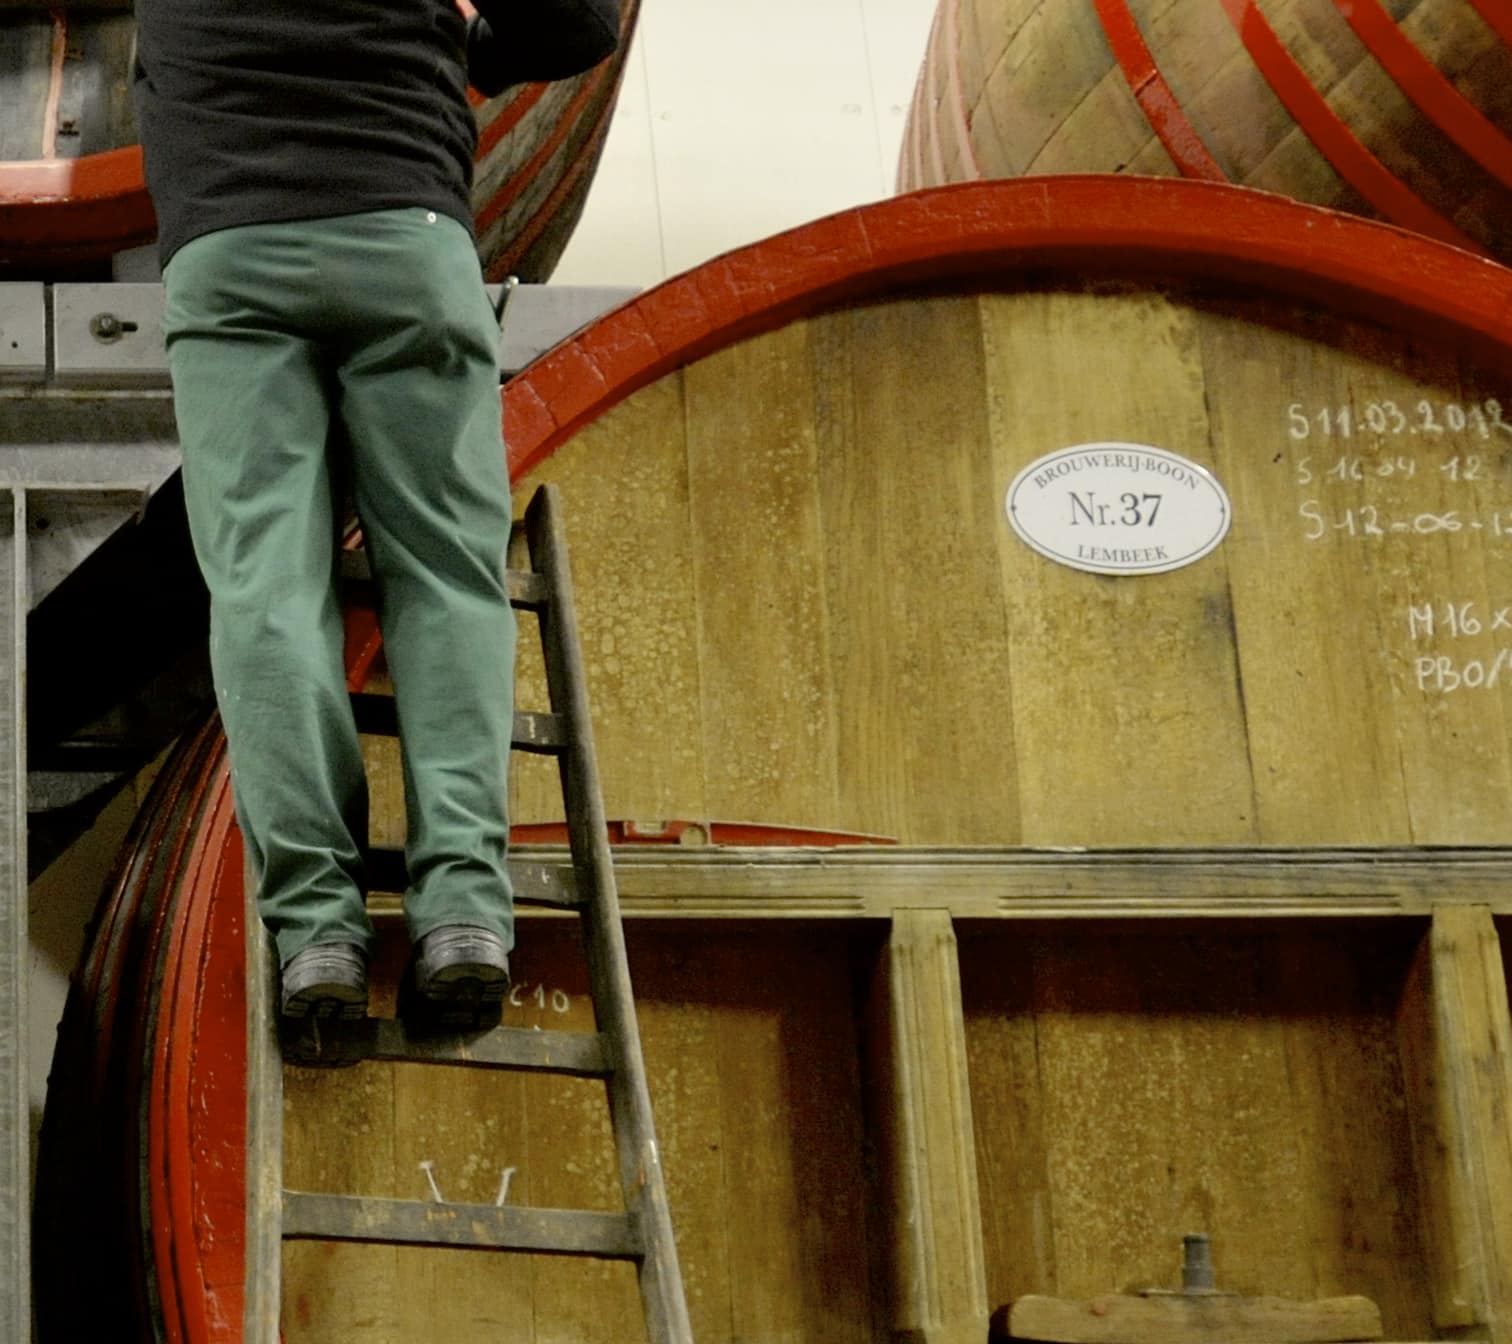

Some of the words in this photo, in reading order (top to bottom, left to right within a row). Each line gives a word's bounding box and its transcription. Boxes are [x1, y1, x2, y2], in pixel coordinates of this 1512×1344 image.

[1033, 454, 1140, 489] BROUWERIJ
[1142, 456, 1201, 491] BOON
[1077, 543, 1169, 564] LEMBEEK
